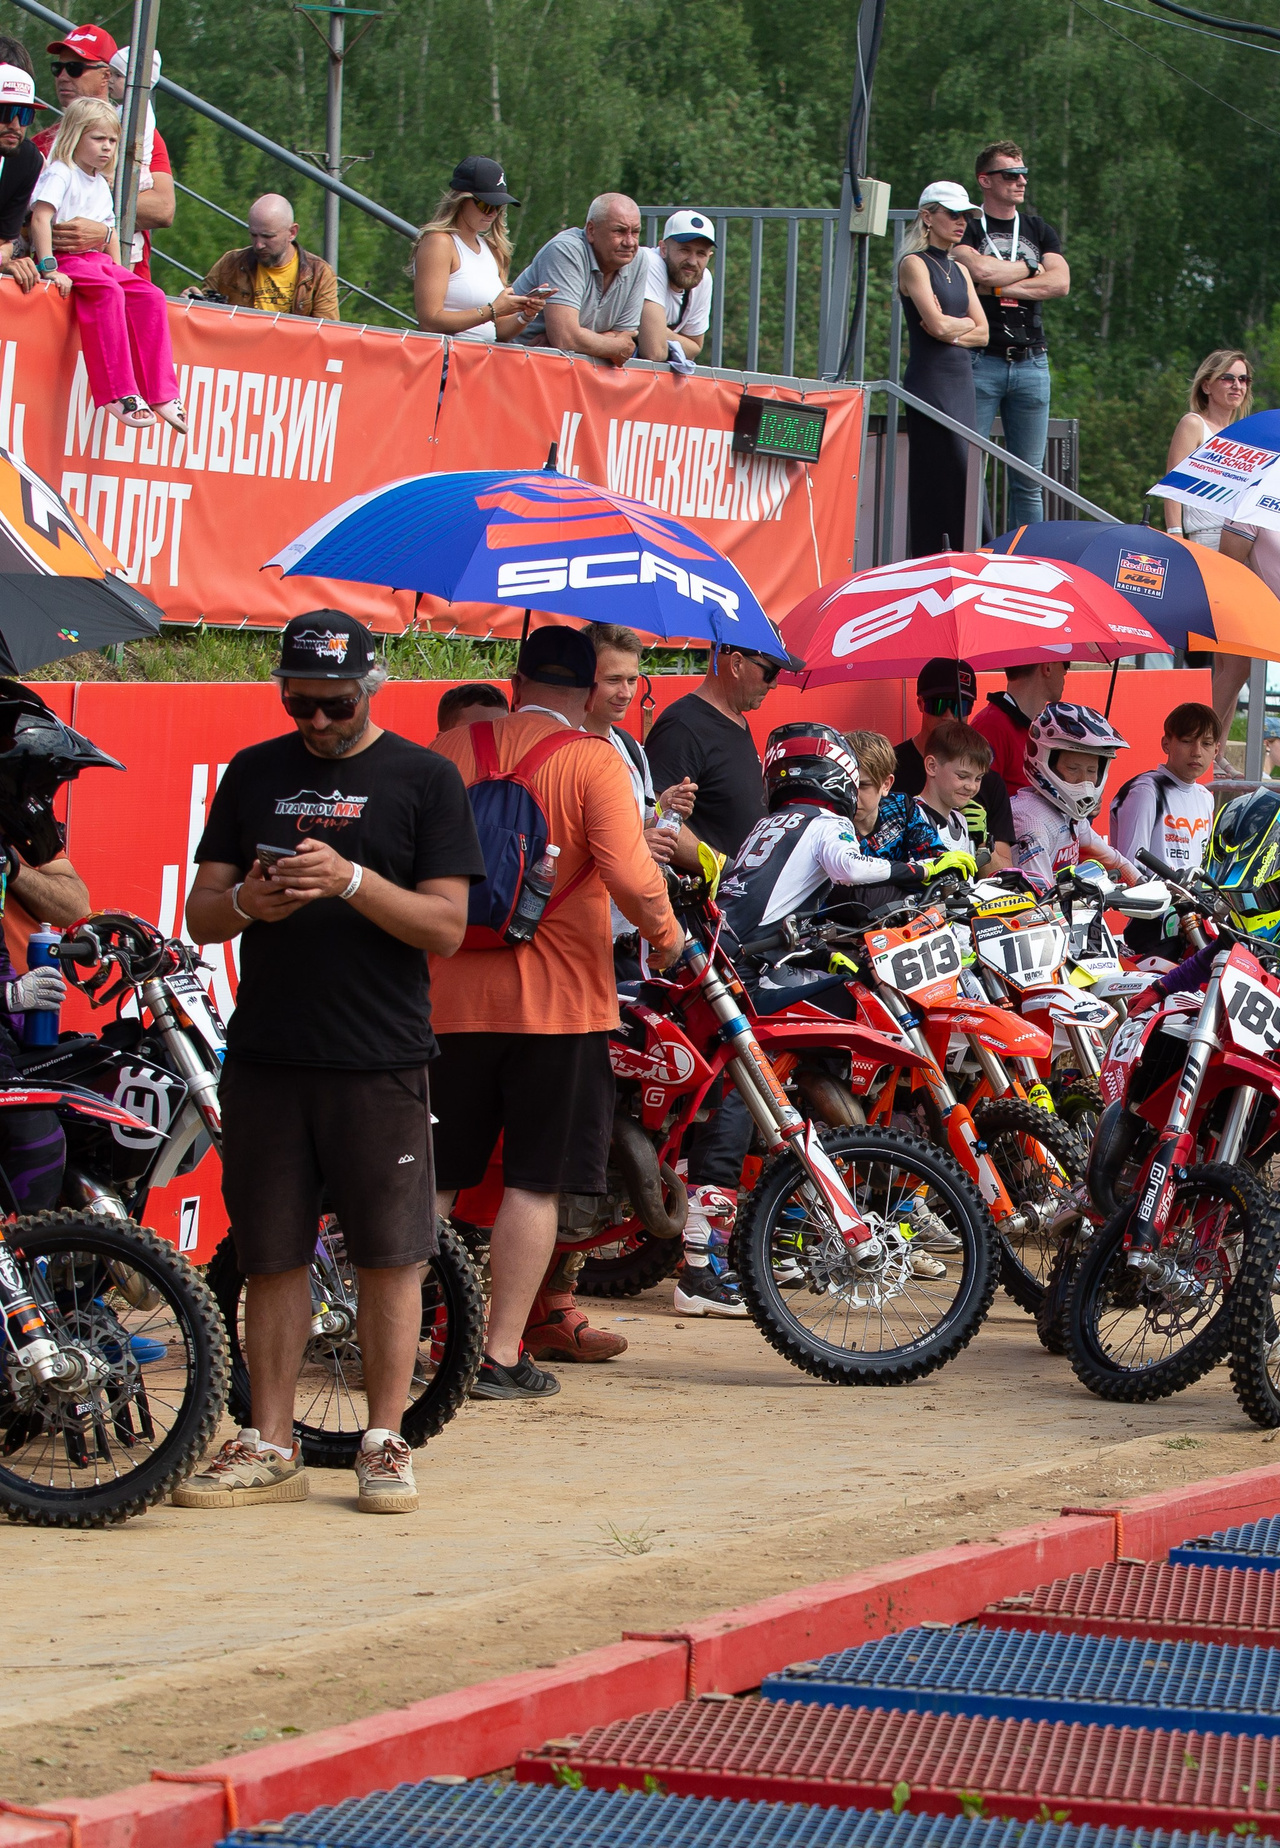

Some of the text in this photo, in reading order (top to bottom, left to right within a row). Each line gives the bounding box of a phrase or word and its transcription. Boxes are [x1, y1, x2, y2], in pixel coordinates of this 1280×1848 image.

[756, 413, 821, 452] 13:26:01
[1205, 438, 1274, 466] MILYAEV
[1120, 559, 1165, 576] Red Bull
[1124, 574, 1157, 585] KTM
[497, 551, 740, 622] SCAR
[1116, 583, 1161, 597] RACING TEAM
[831, 583, 1075, 658] EVS
[891, 934, 960, 991] 613
[999, 929, 1057, 974] 117
[1086, 961, 1116, 971] VASKOV
[1073, 1001, 1097, 1010] KTM
[748, 1041, 792, 1107] GREEN
[1030, 1088, 1048, 1098] KTM
